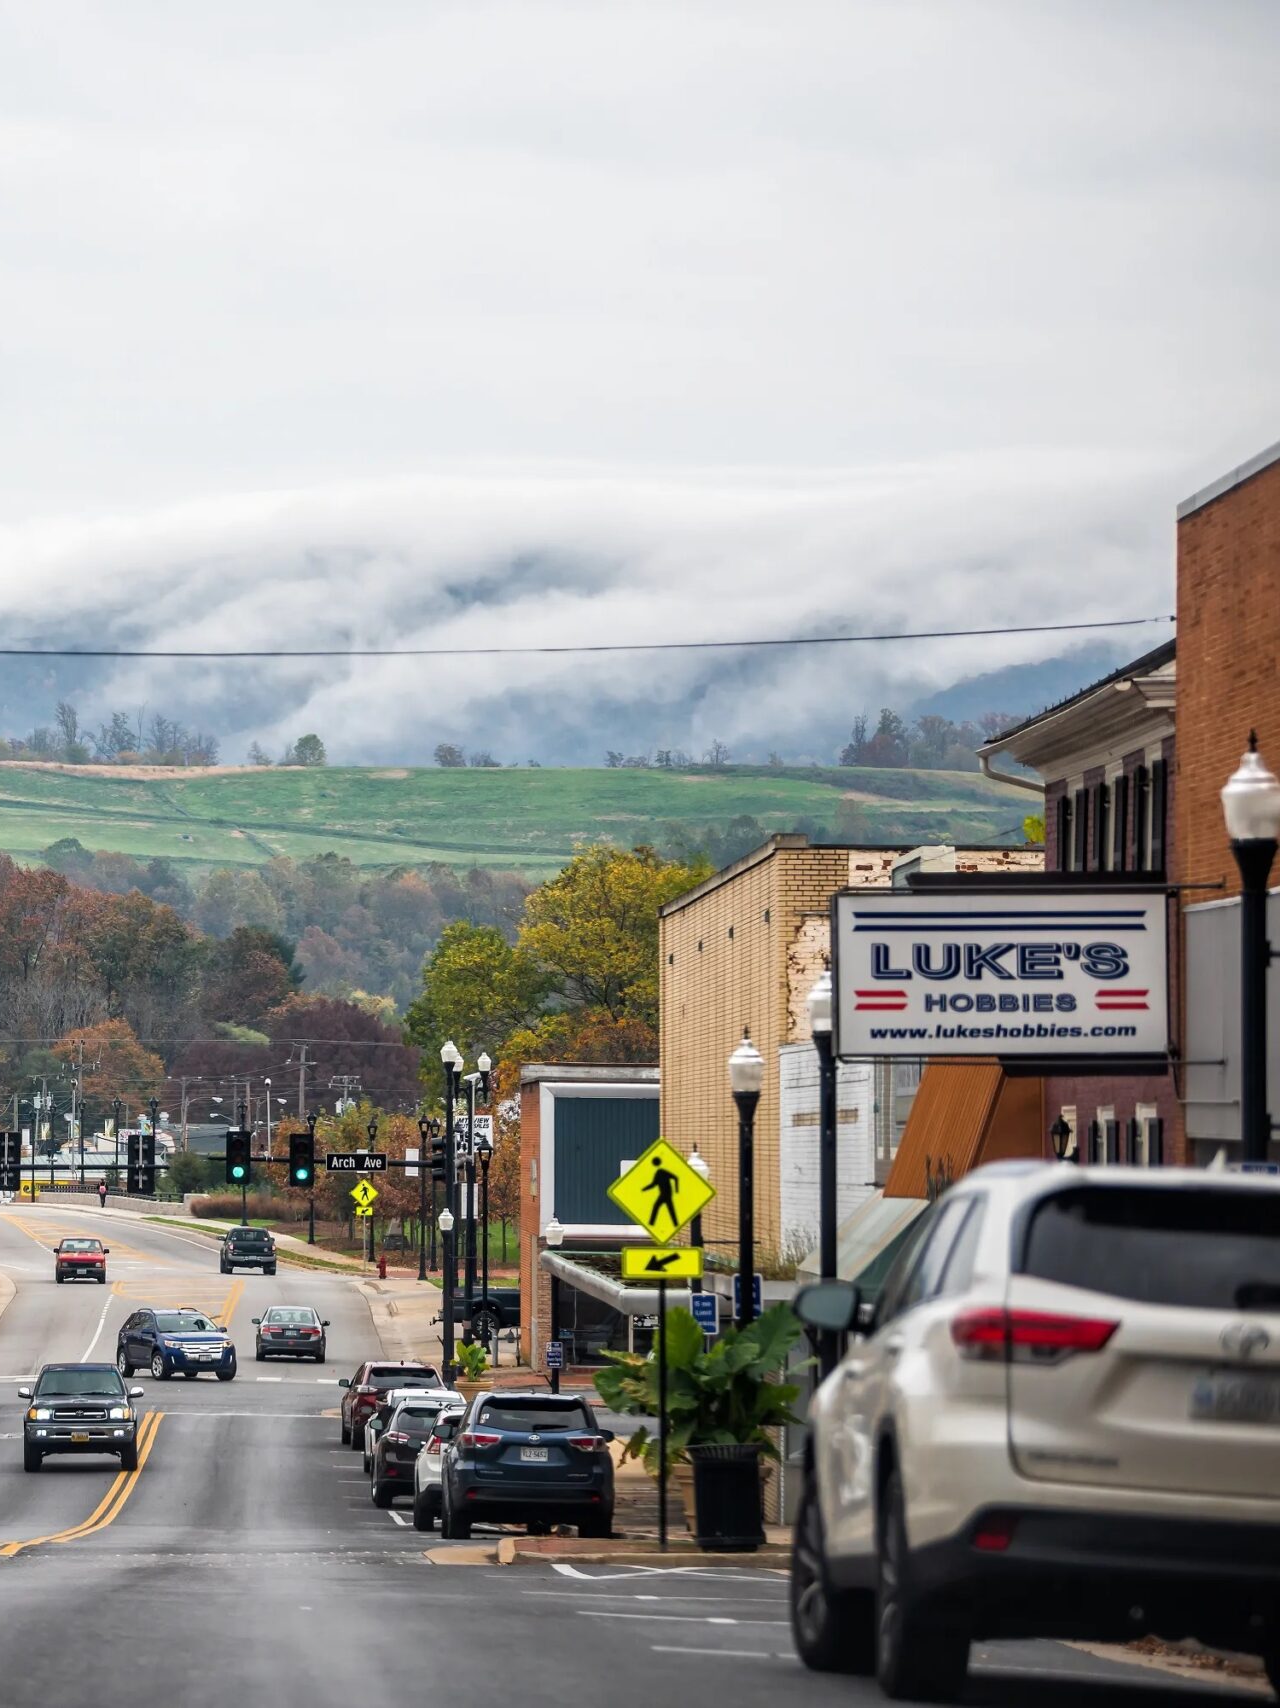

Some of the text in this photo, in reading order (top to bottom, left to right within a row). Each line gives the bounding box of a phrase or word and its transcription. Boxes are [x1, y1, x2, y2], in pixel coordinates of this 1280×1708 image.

[870, 942, 1130, 981] LUKE'S
[924, 993, 1078, 1013] HOBBIES
[870, 1023, 1137, 1039] www.lukeshobbies.com
[331, 1156, 382, 1168] Arch Ave
